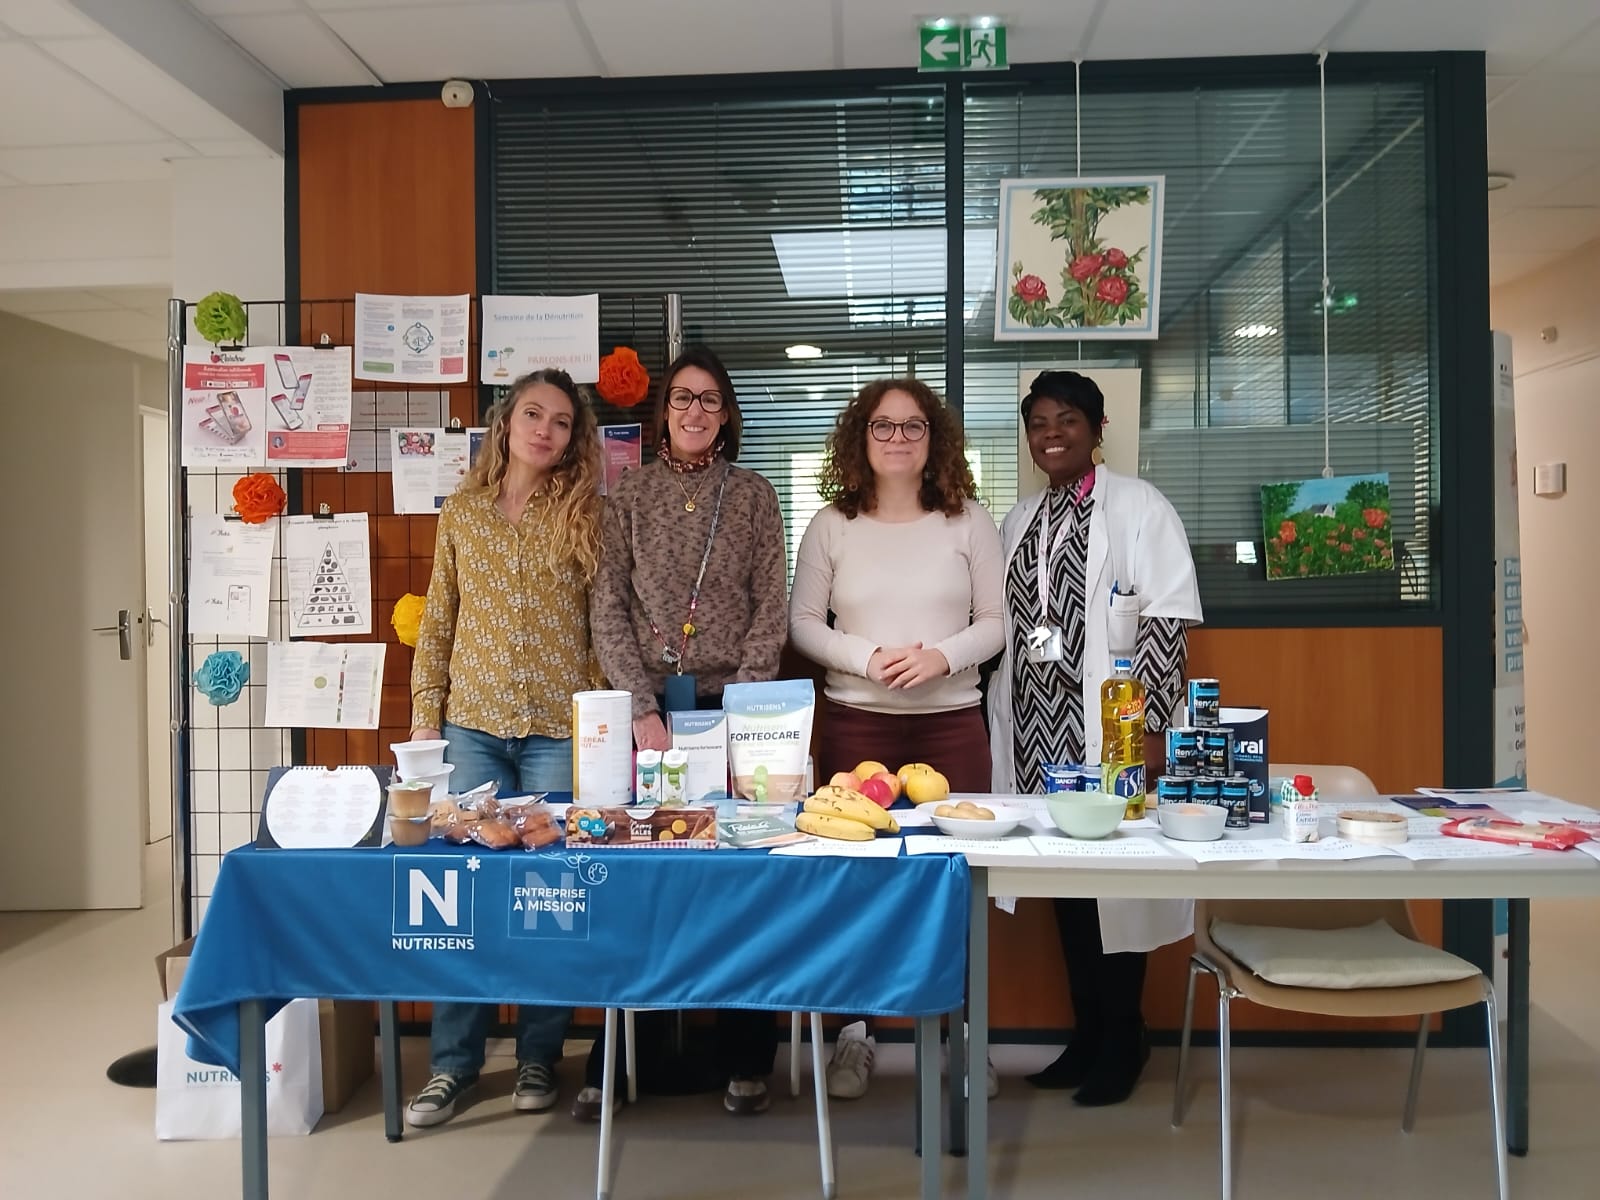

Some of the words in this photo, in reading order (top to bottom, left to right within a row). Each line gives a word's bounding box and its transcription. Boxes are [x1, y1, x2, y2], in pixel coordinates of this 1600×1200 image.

[730, 731, 800, 742] FORTEOCARE
[408, 868, 459, 927] N
[513, 887, 586, 899] ENTREPRISE
[513, 897, 524, 912] À
[527, 901, 586, 913] MISSION
[391, 937, 475, 951] NUTRISENS
[186, 1070, 271, 1084] NUTRIS
